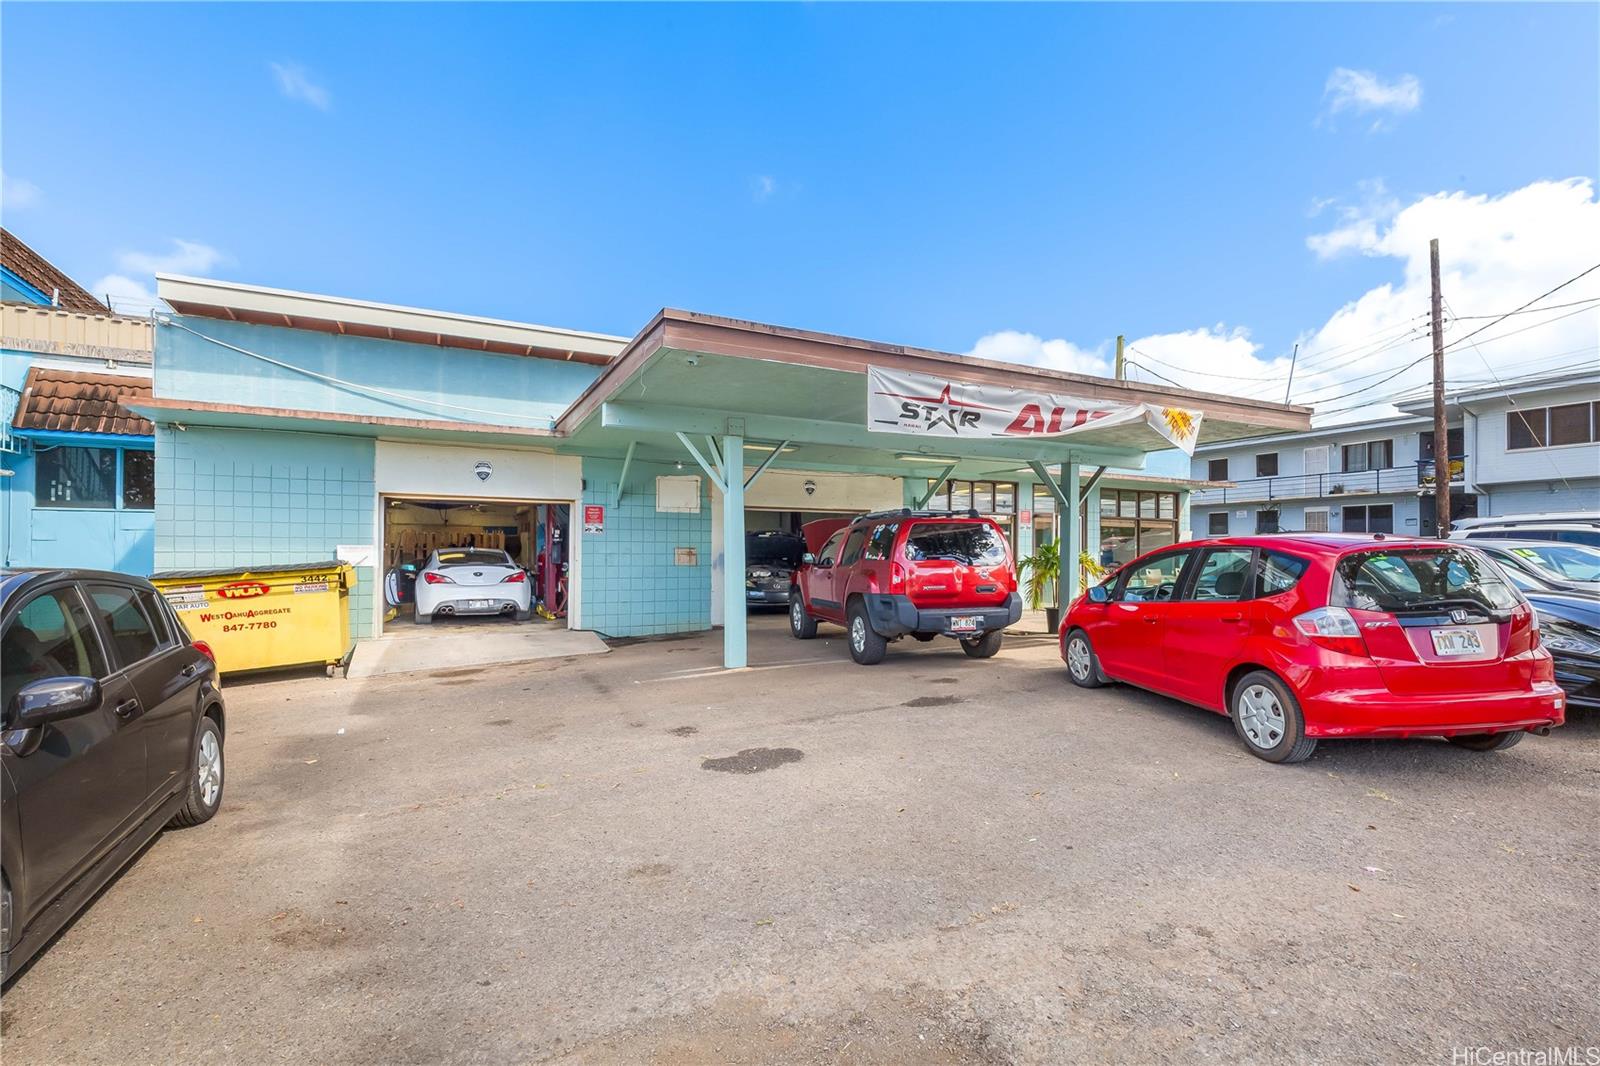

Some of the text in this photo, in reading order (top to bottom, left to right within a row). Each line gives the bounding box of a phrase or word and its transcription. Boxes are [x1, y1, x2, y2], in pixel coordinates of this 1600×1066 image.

[899, 400, 1115, 434] STAR AU
[300, 574, 328, 583] 3442
[223, 620, 277, 633] 847-7780
